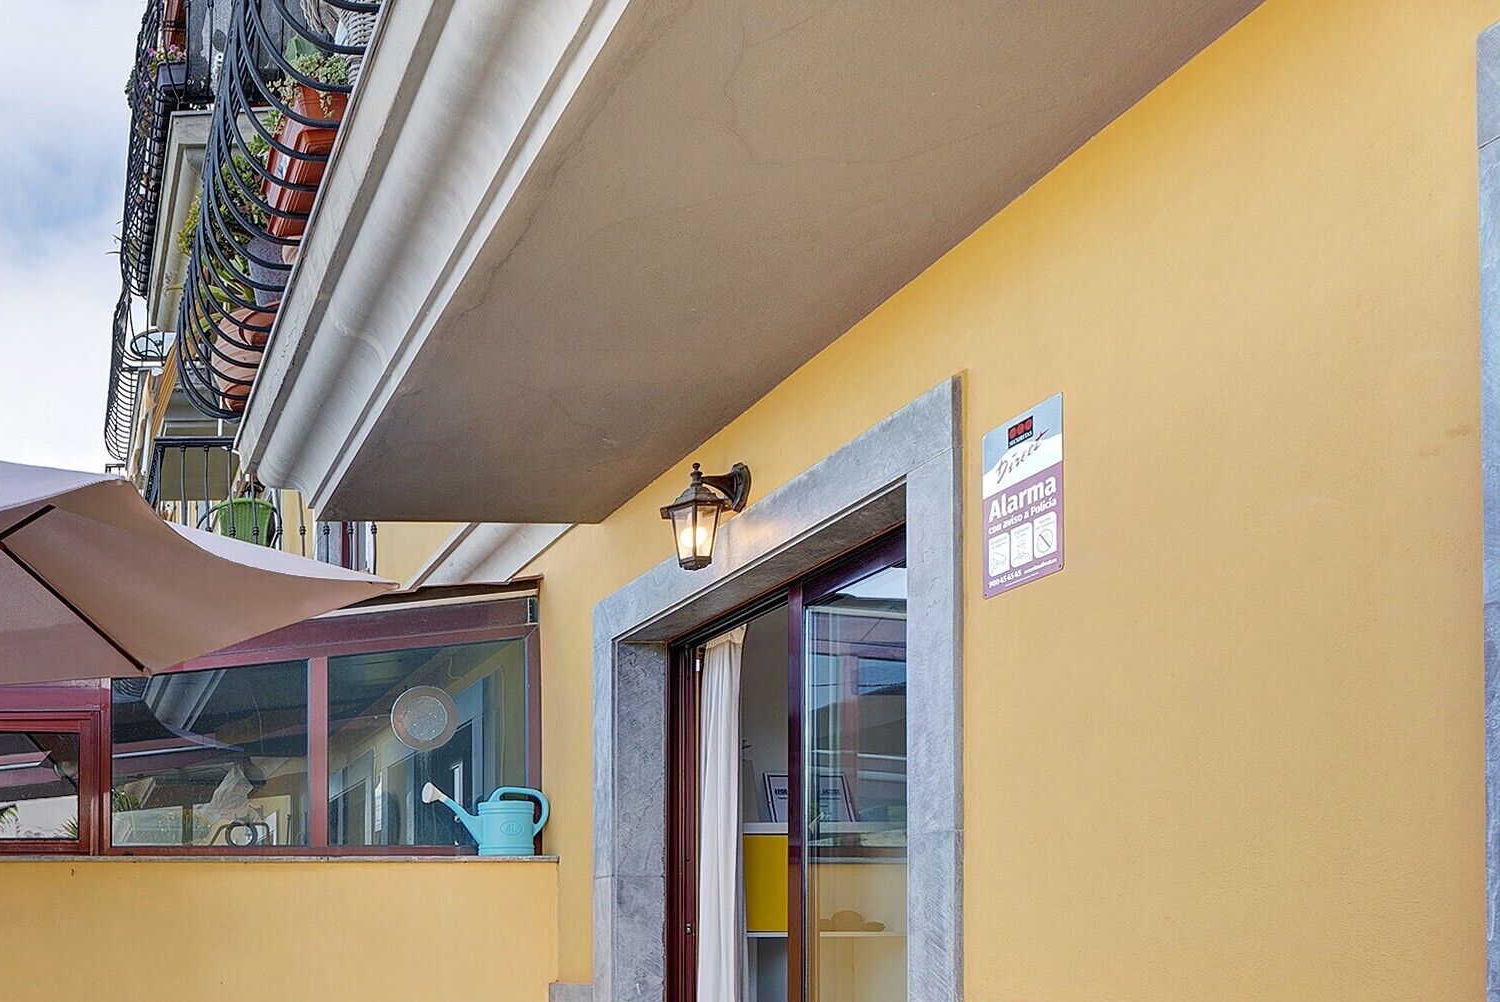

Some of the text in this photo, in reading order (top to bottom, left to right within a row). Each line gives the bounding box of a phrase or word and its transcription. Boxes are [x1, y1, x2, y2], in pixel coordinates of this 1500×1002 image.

[988, 476, 1058, 523] Alarma
[988, 523, 1003, 535] con
[1003, 513, 1024, 529] aviso
[1023, 511, 1030, 520] a
[1030, 497, 1057, 516] Policía
